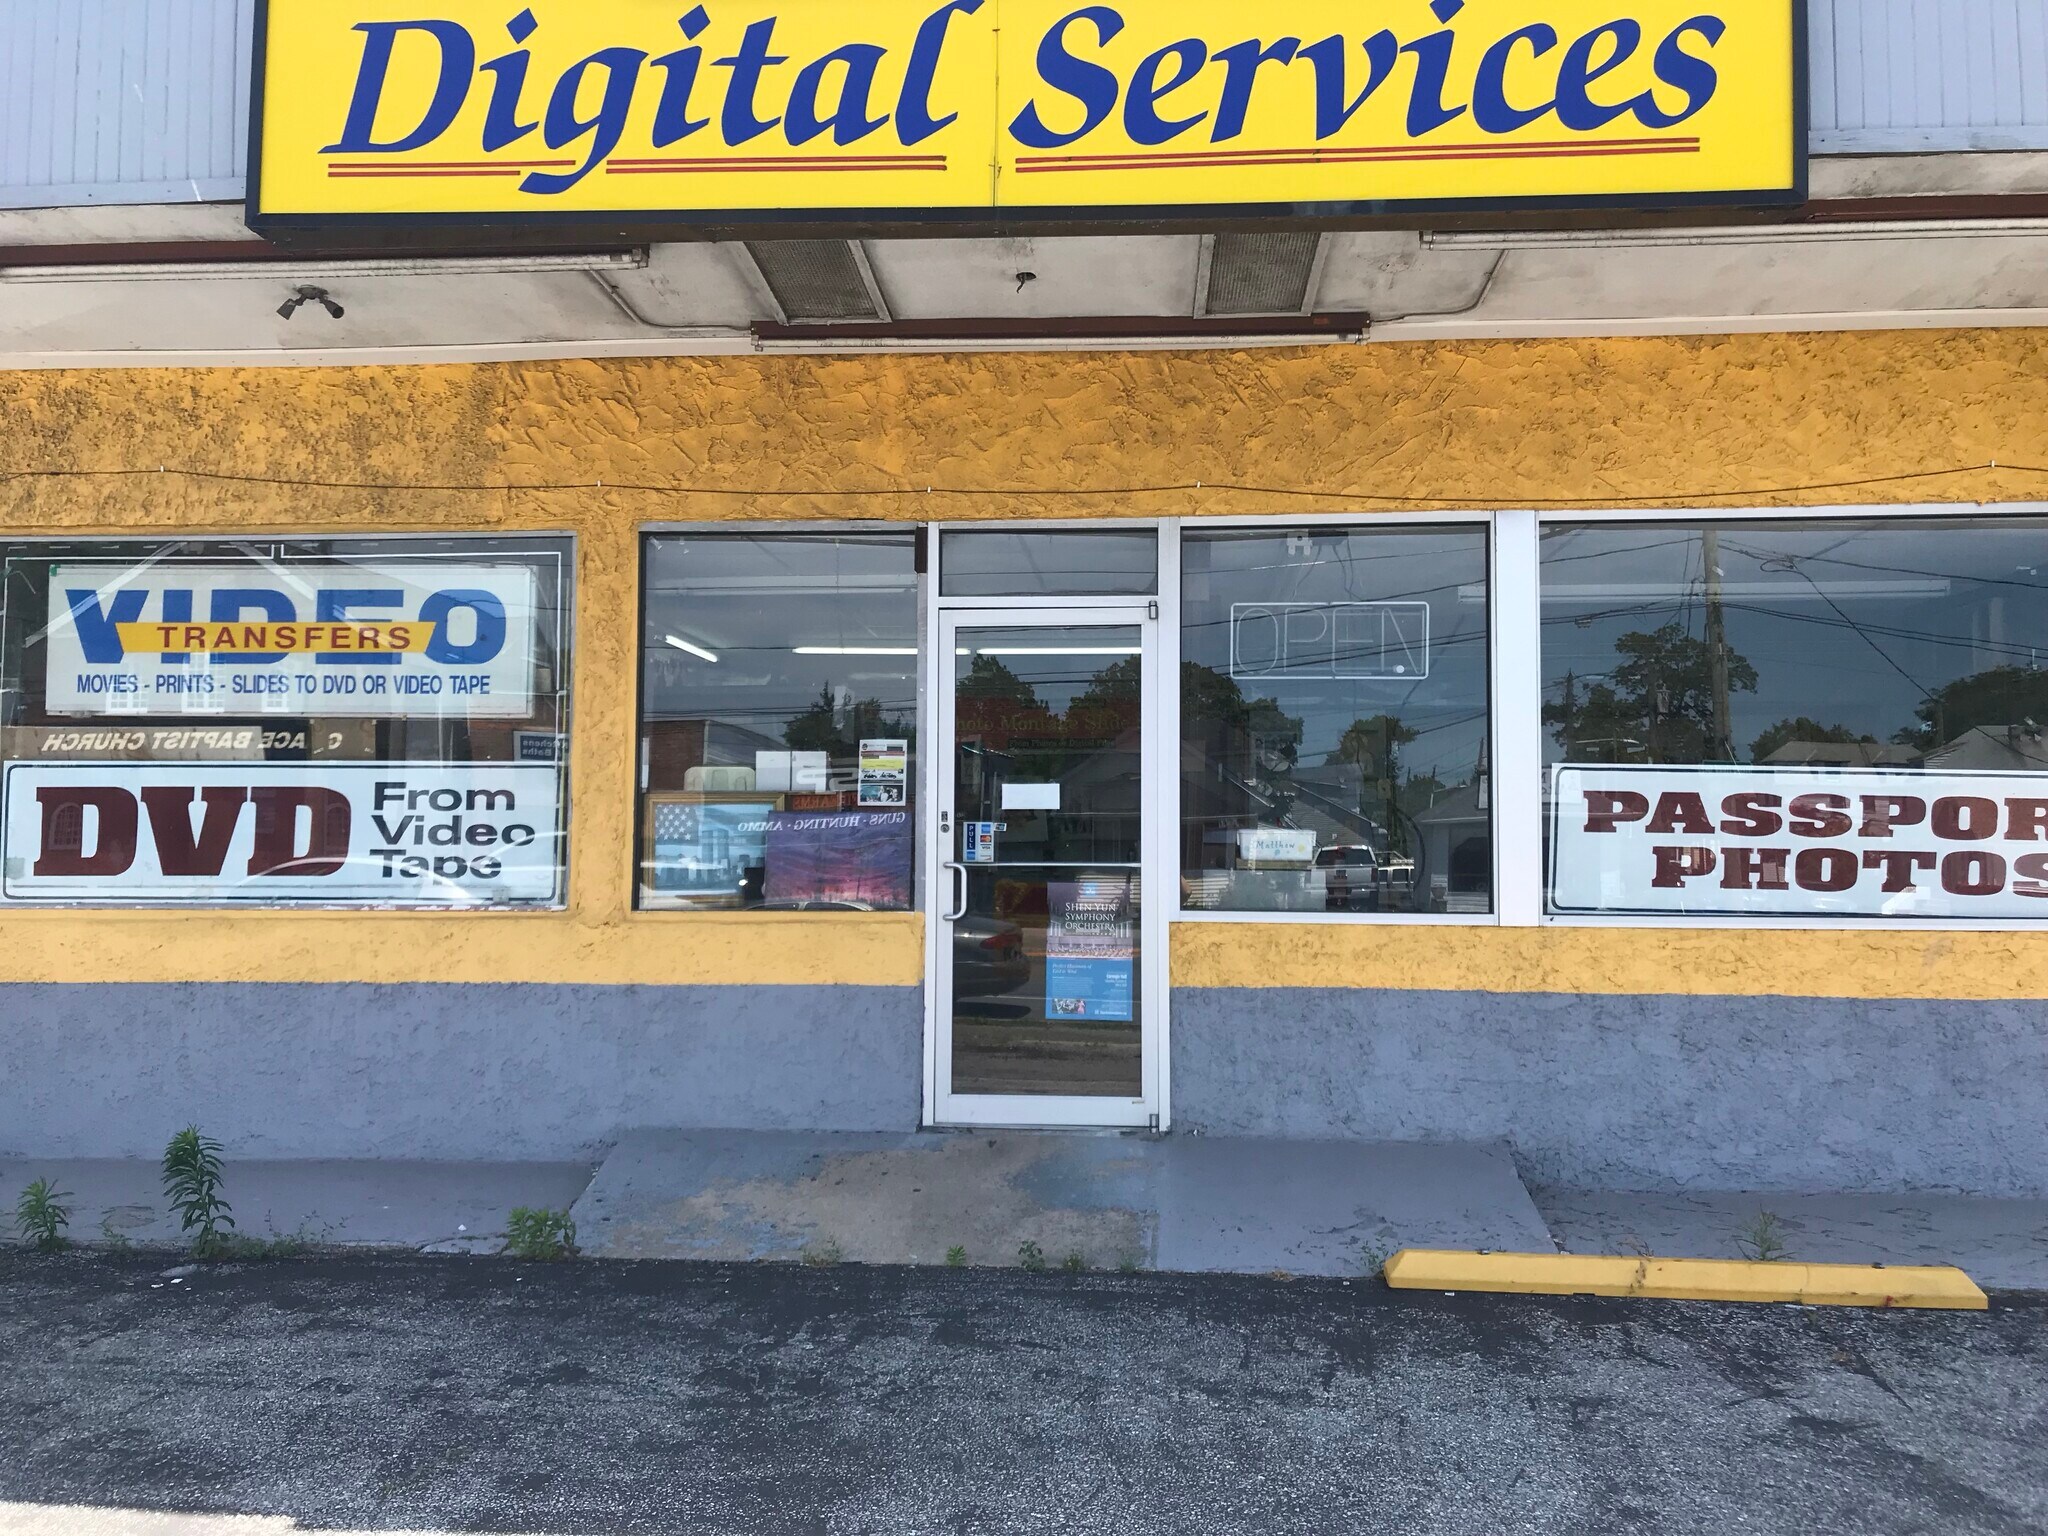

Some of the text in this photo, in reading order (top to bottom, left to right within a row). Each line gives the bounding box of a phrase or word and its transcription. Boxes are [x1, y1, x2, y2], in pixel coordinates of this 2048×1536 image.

[317, 0, 1727, 194] Digital Services
[65, 588, 506, 665] VIDEO
[156, 625, 411, 650] TRANSFERS
[1236, 605, 1424, 675] OPEN
[77, 674, 138, 694] MOVIES
[155, 674, 214, 694] PRINTS
[232, 674, 289, 694] SLIDES
[294, 674, 317, 694] TO
[323, 674, 356, 694] DVD
[363, 674, 386, 694] OR
[395, 674, 442, 694] VIDEO
[449, 674, 490, 694] TAPE
[33, 782, 515, 876] DVD From
[371, 814, 535, 846] Video
[1256, 840, 1295, 849] Matthew
[369, 849, 501, 887] Tape
[1651, 845, 2048, 898] PHOTOS
[1065, 902, 1116, 912] SHEN YUN
[1065, 913, 1116, 921] SYMPHONY
[1065, 922, 1116, 930] ORCHESTRA
